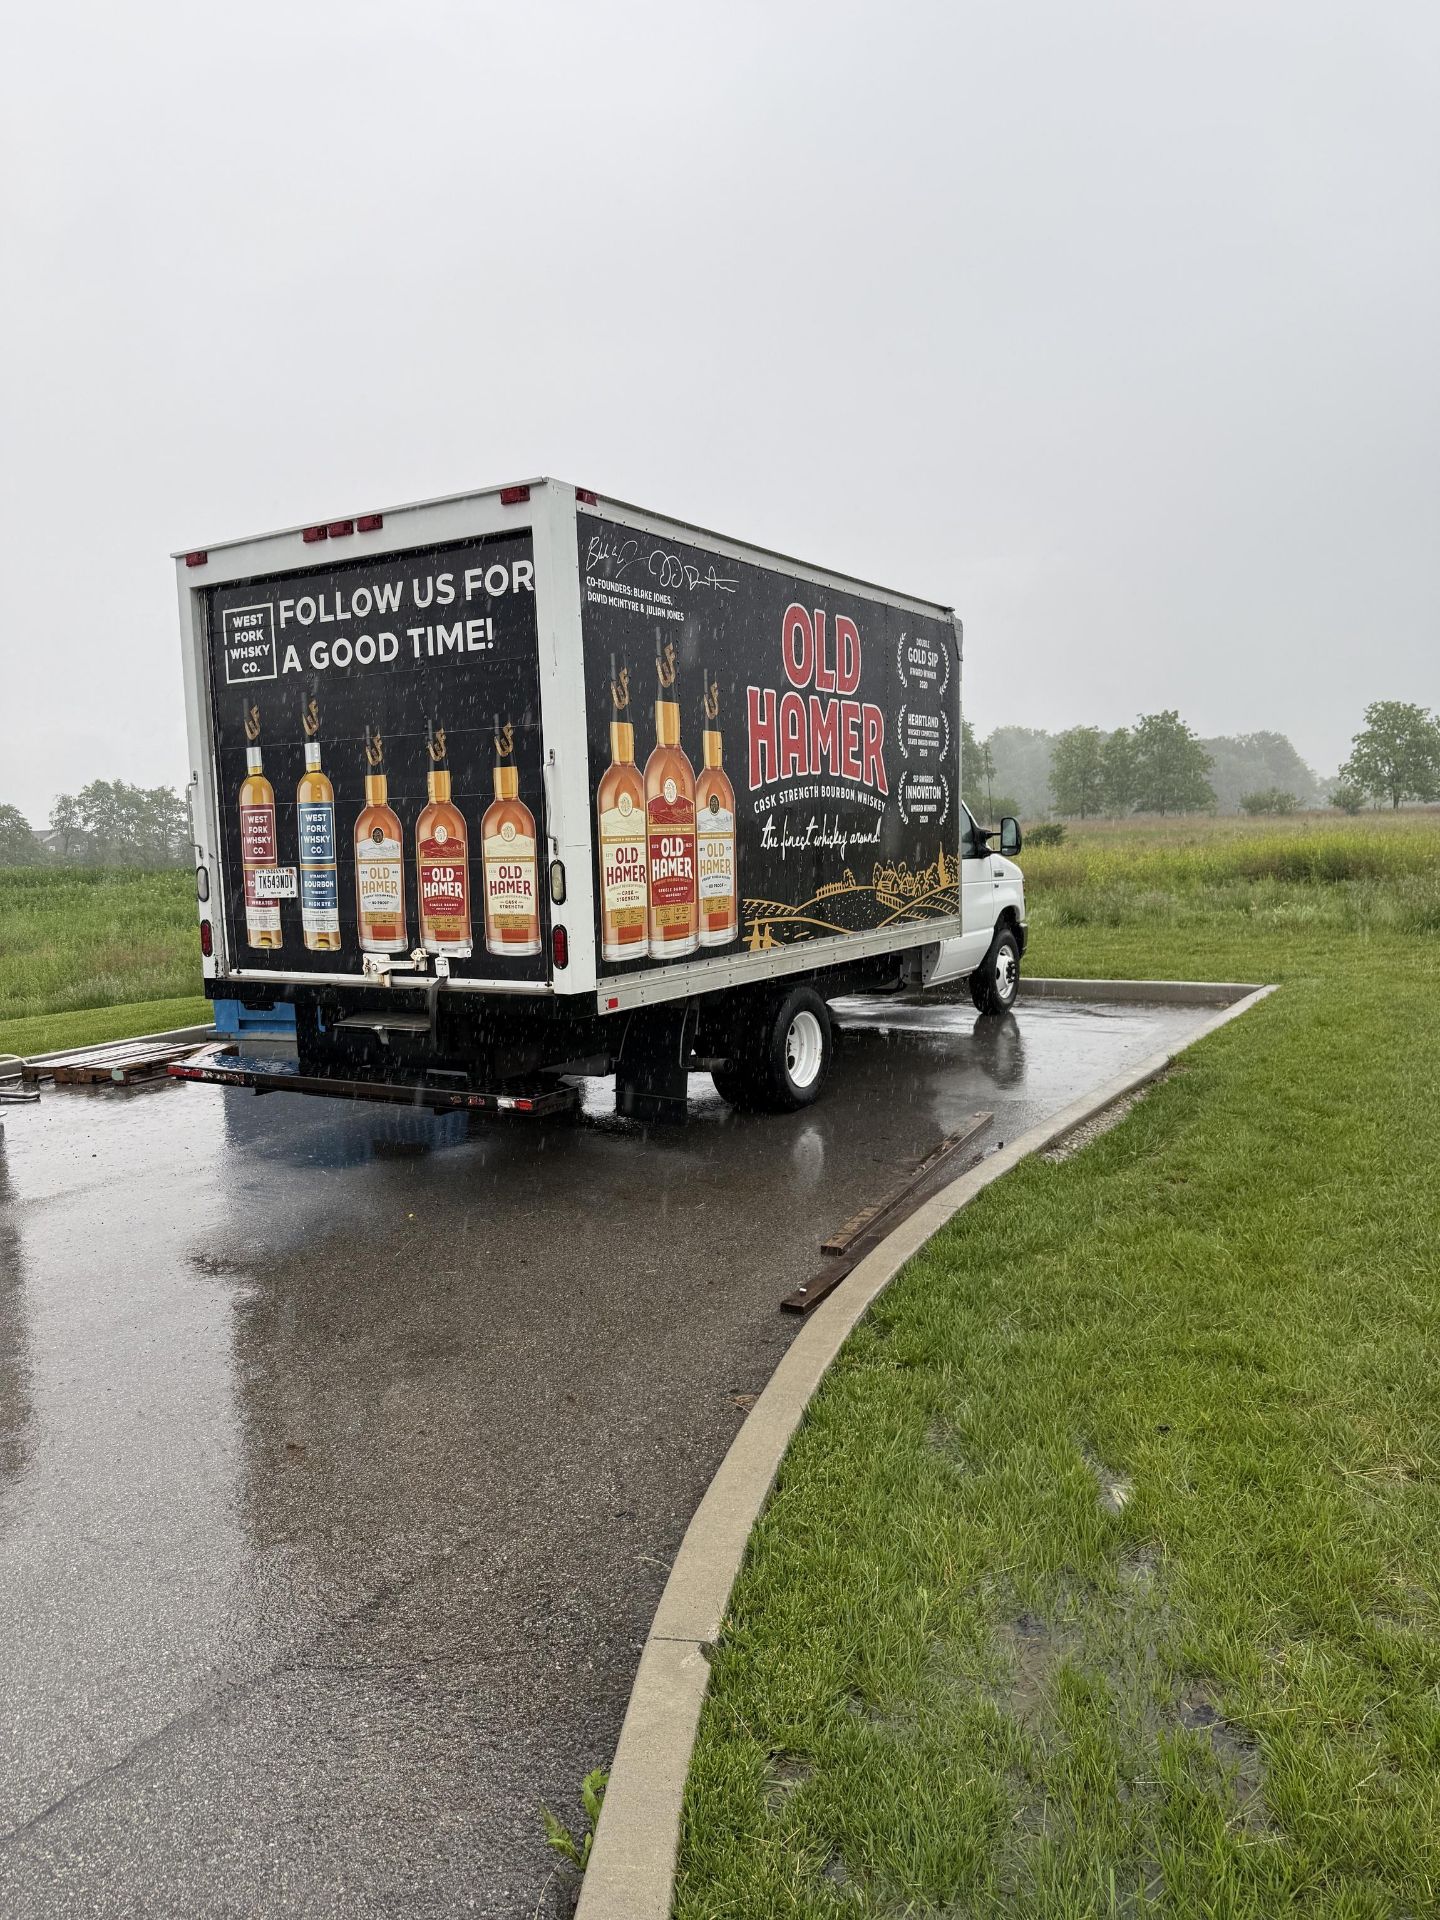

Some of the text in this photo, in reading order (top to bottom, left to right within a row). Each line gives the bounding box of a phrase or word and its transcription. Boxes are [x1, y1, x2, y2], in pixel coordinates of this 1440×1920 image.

[279, 560, 535, 629] FOLLOW US FOR
[586, 576, 633, 597] CO-FOUNDERS:
[633, 589, 653, 601] BLAKE
[587, 591, 685, 622] DAVID MCINTYRE & JULIAN JONES
[233, 613, 263, 628] WEST
[234, 629, 264, 644] FORK
[230, 644, 270, 660] WHSKY
[282, 617, 494, 674] A GOOD TIME!
[782, 602, 862, 696] OLD
[908, 647, 939, 668] GOLD SIP
[242, 662, 261, 674] CO.
[909, 667, 923, 677] AWARD
[907, 713, 939, 728] HEARTLAND
[746, 685, 889, 796] HAMER
[753, 785, 886, 815] CASK STRENGTH BOURBON WHISKEY
[247, 815, 268, 824] WEST
[305, 813, 327, 822] WEST
[248, 825, 268, 834] FORK
[306, 824, 327, 833] FORK
[760, 813, 779, 850] the
[780, 814, 819, 861] finest
[814, 812, 848, 861] whiskey
[246, 836, 271, 844] WHSKY
[303, 835, 331, 843] WHSKY
[661, 837, 684, 857] OLD
[253, 846, 266, 854] CO.
[310, 846, 324, 854] CO.
[615, 847, 639, 865] OLD
[707, 842, 725, 858] OLD
[369, 867, 390, 880] OLD
[431, 867, 455, 882] OLD
[499, 865, 523, 879] OLD
[606, 864, 647, 887] HAMER
[652, 857, 693, 882] HAMER
[700, 859, 732, 878] HAMER
[304, 880, 334, 888] BOURBON
[361, 880, 399, 896] HAMER
[423, 881, 464, 899] HAMER
[489, 880, 532, 897] HAMER
